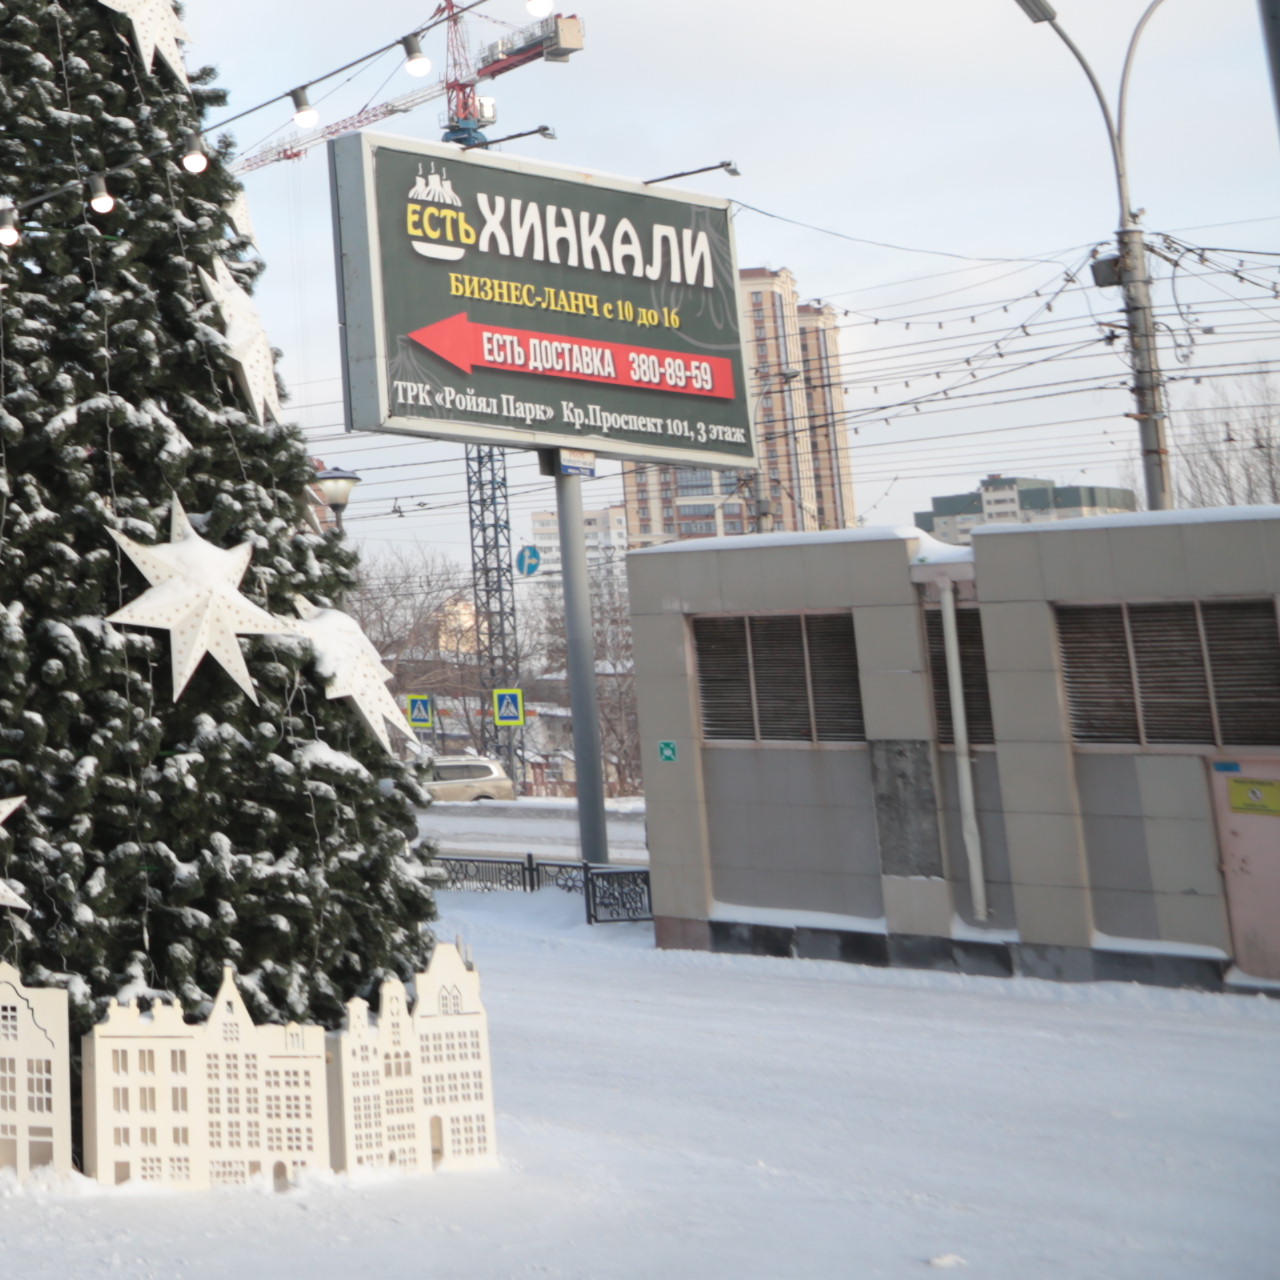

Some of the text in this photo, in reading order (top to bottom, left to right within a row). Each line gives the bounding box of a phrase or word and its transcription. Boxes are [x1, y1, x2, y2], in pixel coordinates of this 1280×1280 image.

[407, 192, 714, 288] ЕСТЬ ХИНКАЛИ
[449, 273, 680, 329] БИЗНЕС-ЛАНЧ с 10 до 16
[482, 331, 712, 390] ЕСТЬ ДОСТАВКА 380-89-59
[394, 380, 746, 444] ТРК «Ройял Парк» Кр.Проспект 101, 3 этаж
